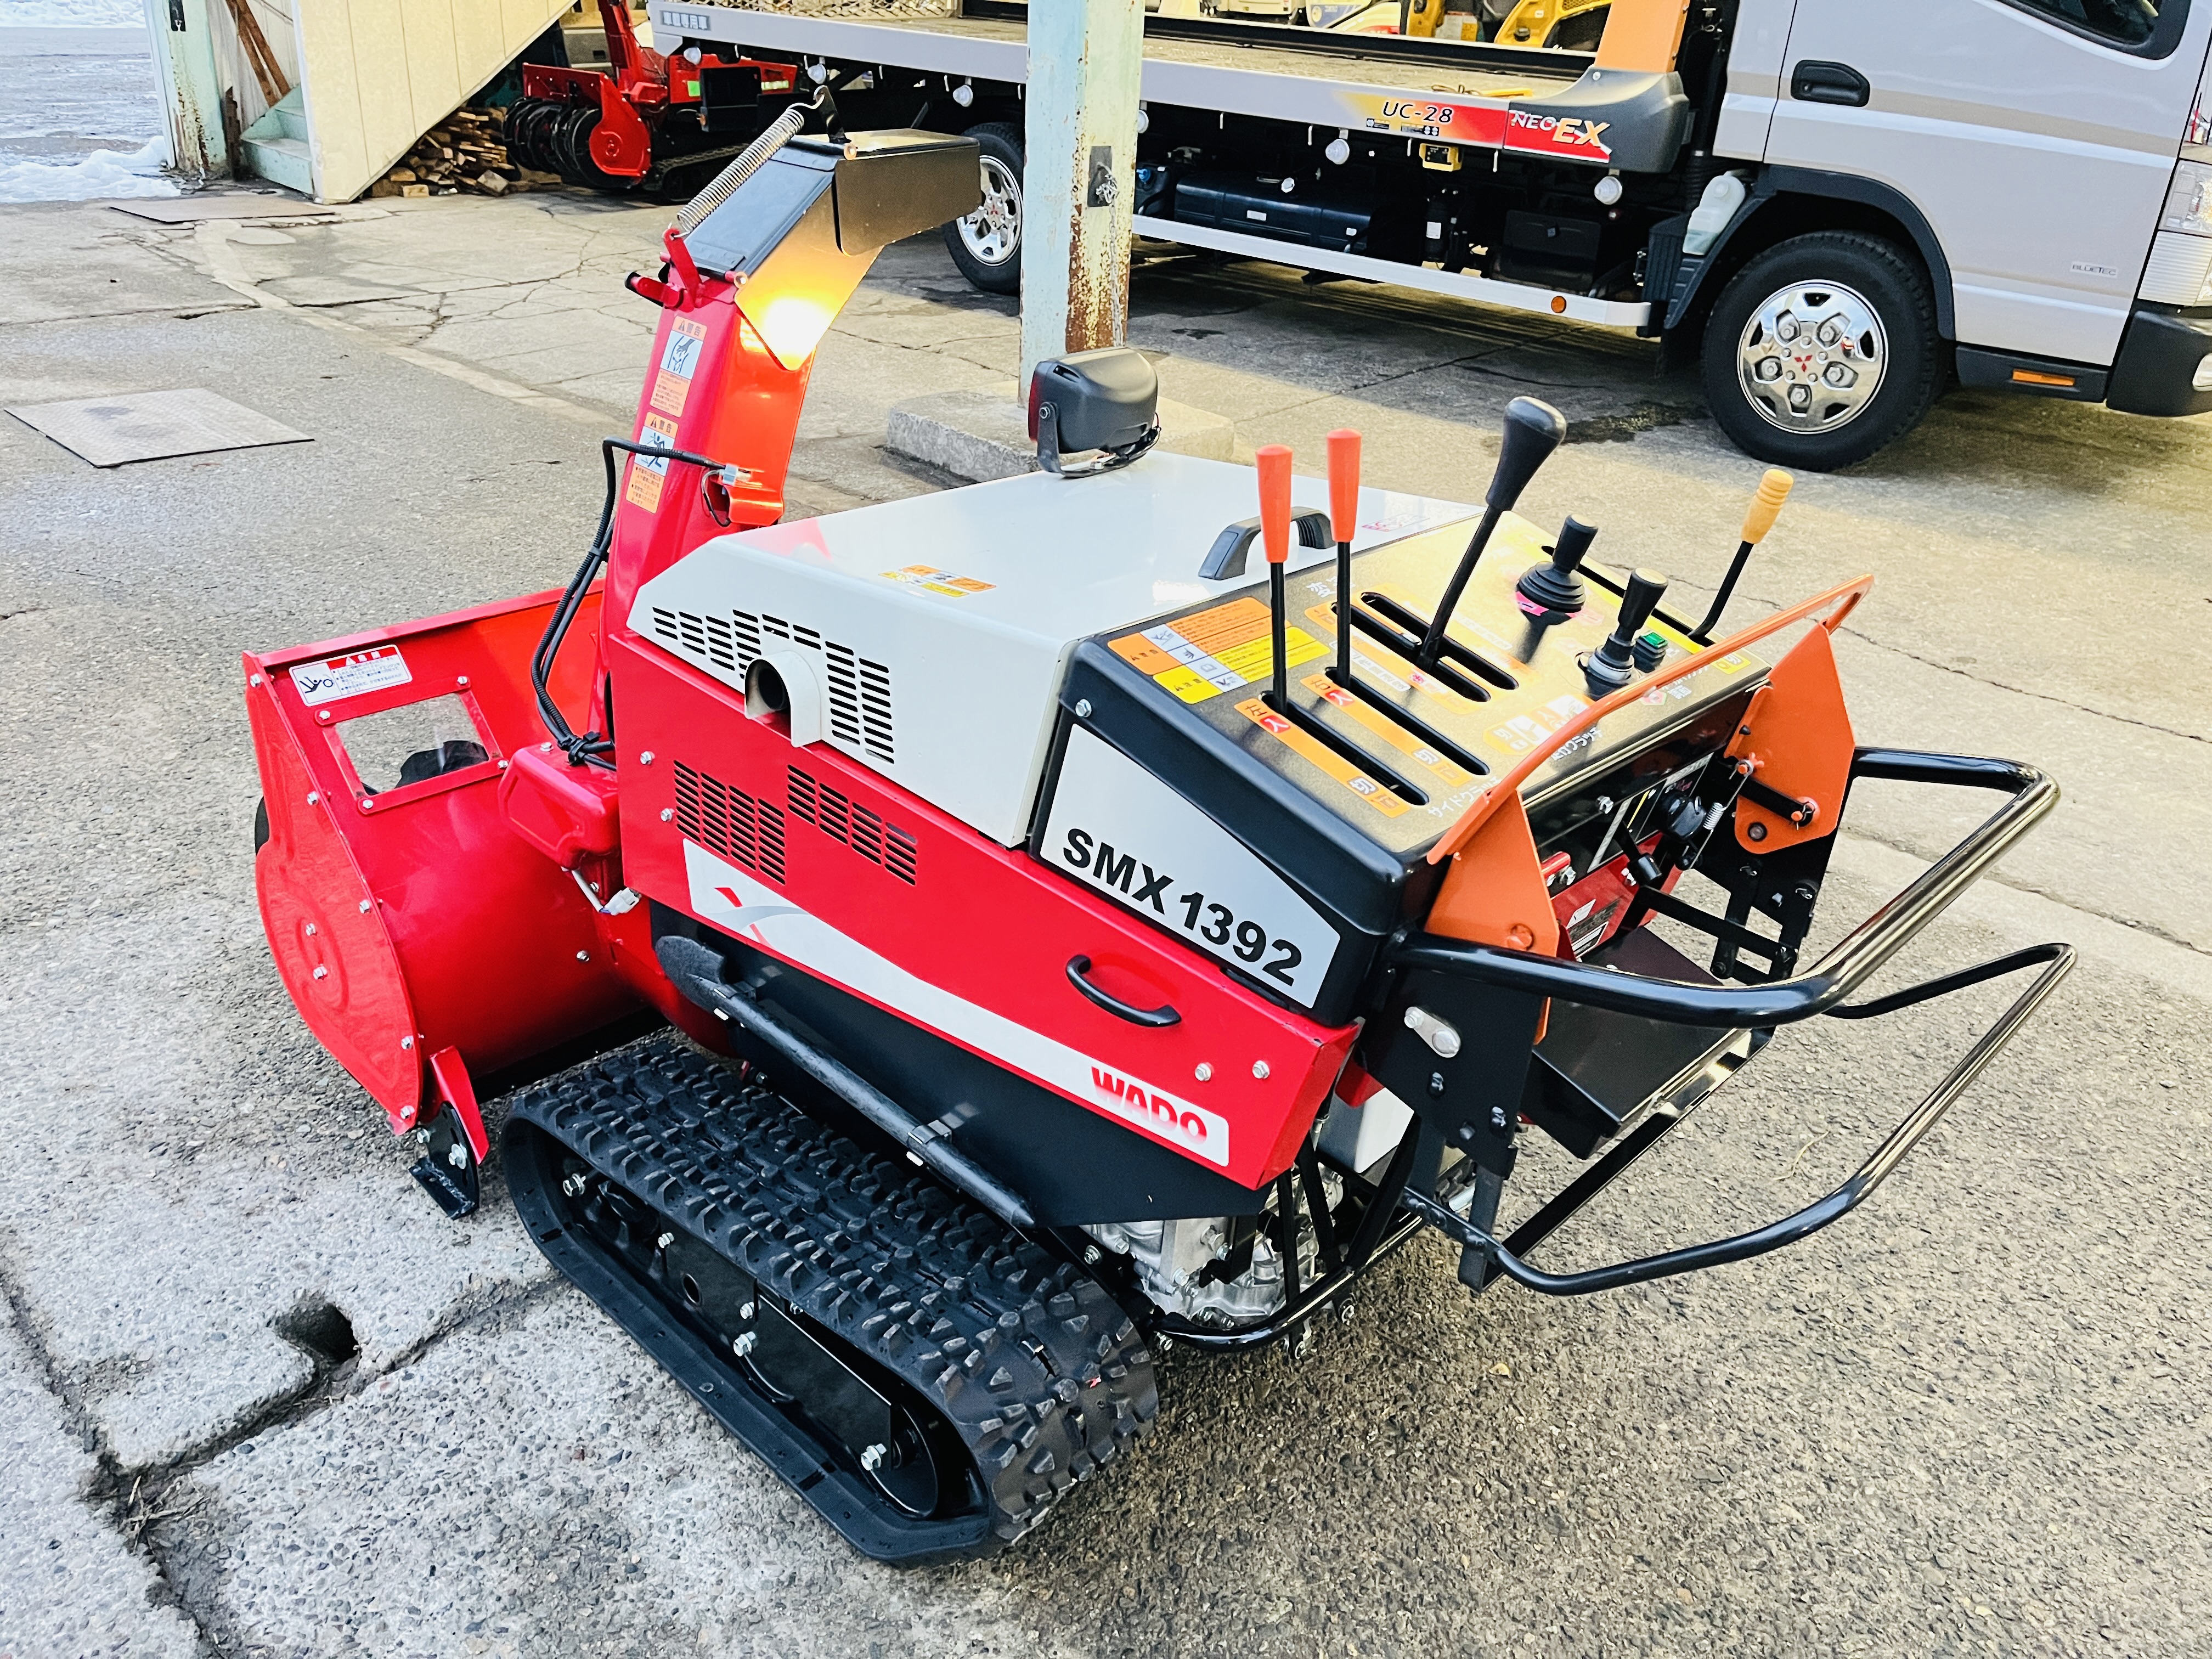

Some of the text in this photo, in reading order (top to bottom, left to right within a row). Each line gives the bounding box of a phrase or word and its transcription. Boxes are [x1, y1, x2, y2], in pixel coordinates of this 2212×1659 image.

[1383, 101, 1453, 123] UC-28
[1552, 117, 1611, 148] EX
[1244, 704, 1377, 795] 左 入 切
[1310, 679, 1441, 765] 右 入 切
[1427, 776, 1502, 818] サイドクラッチ
[1091, 1066, 1207, 1145] WADO
